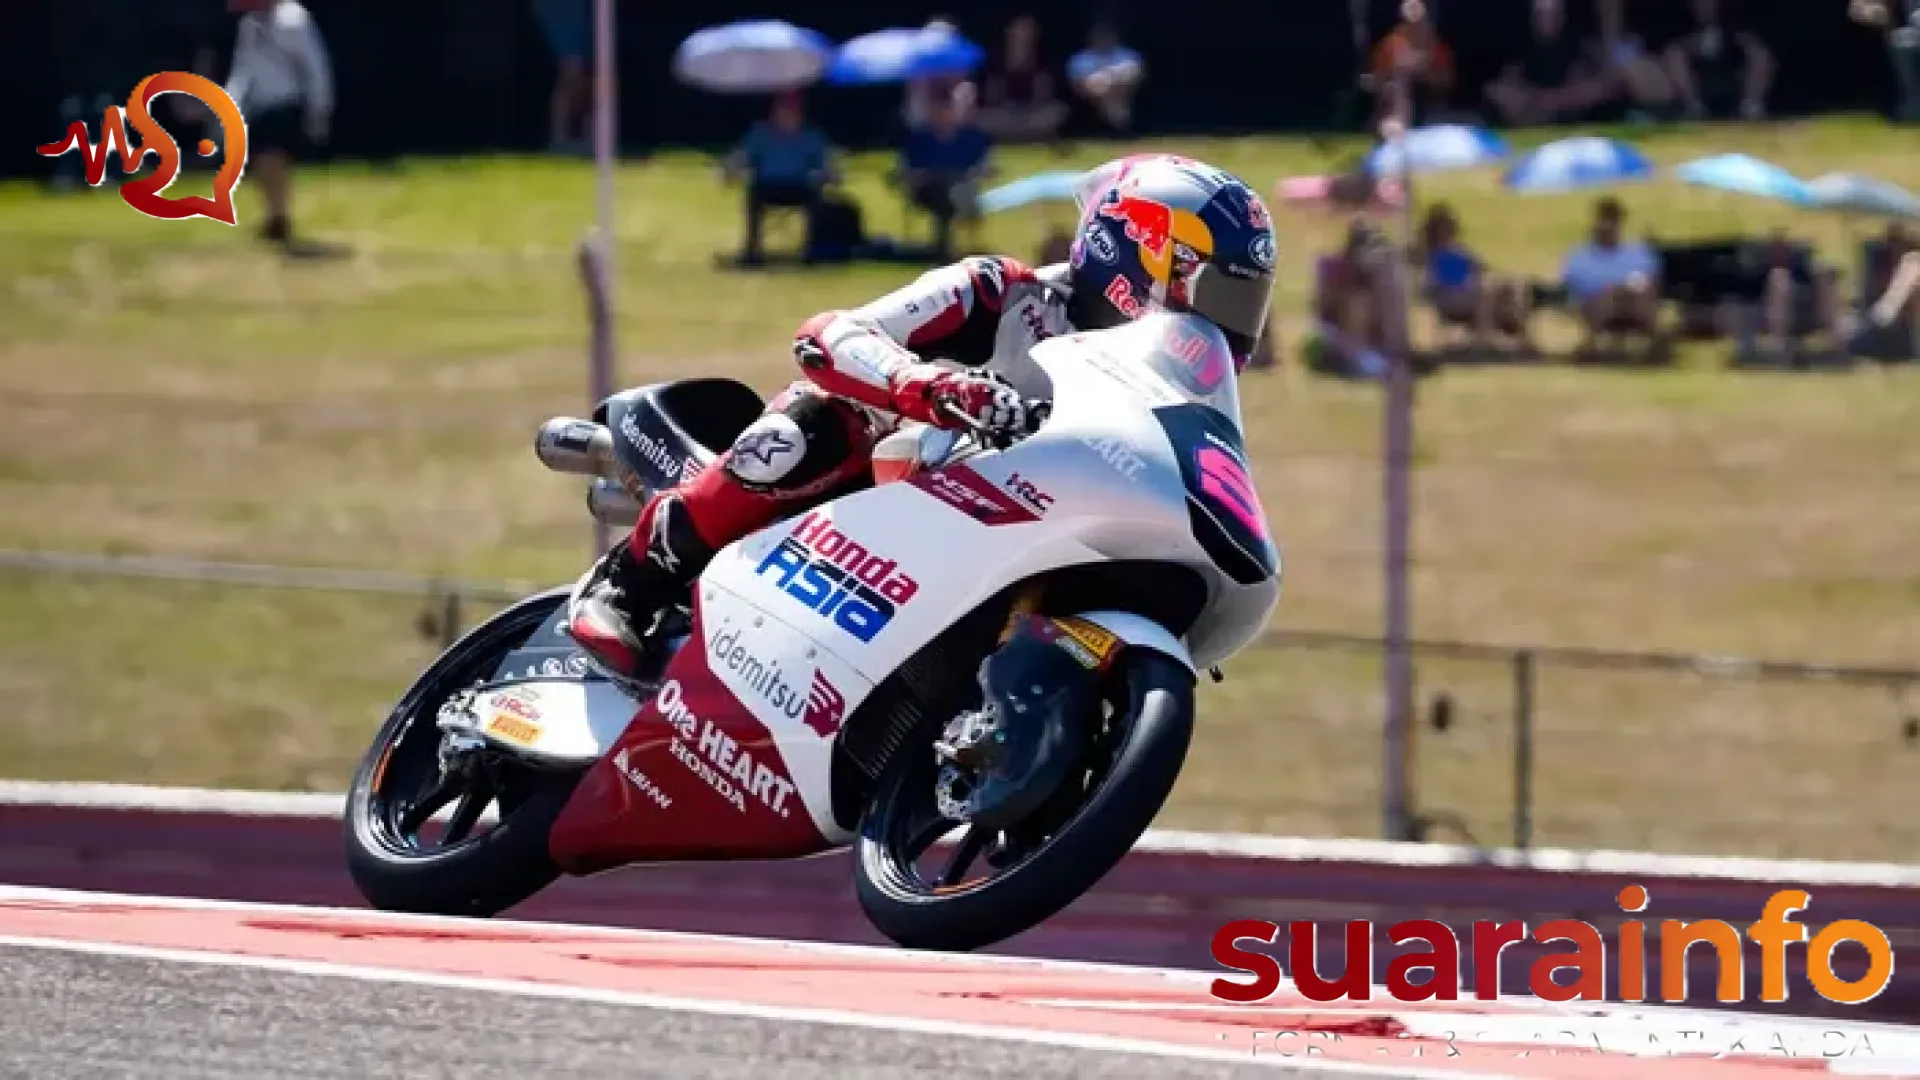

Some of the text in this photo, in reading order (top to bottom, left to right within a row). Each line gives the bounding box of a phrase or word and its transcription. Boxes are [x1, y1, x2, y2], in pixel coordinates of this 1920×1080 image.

[620, 405, 681, 478] idemitsu
[1005, 470, 1057, 513] HRC
[790, 511, 920, 606] Honda
[709, 617, 807, 719] idemitsu
[657, 679, 698, 741] One
[698, 719, 796, 818] HEART.
[669, 735, 747, 814] HONDA
